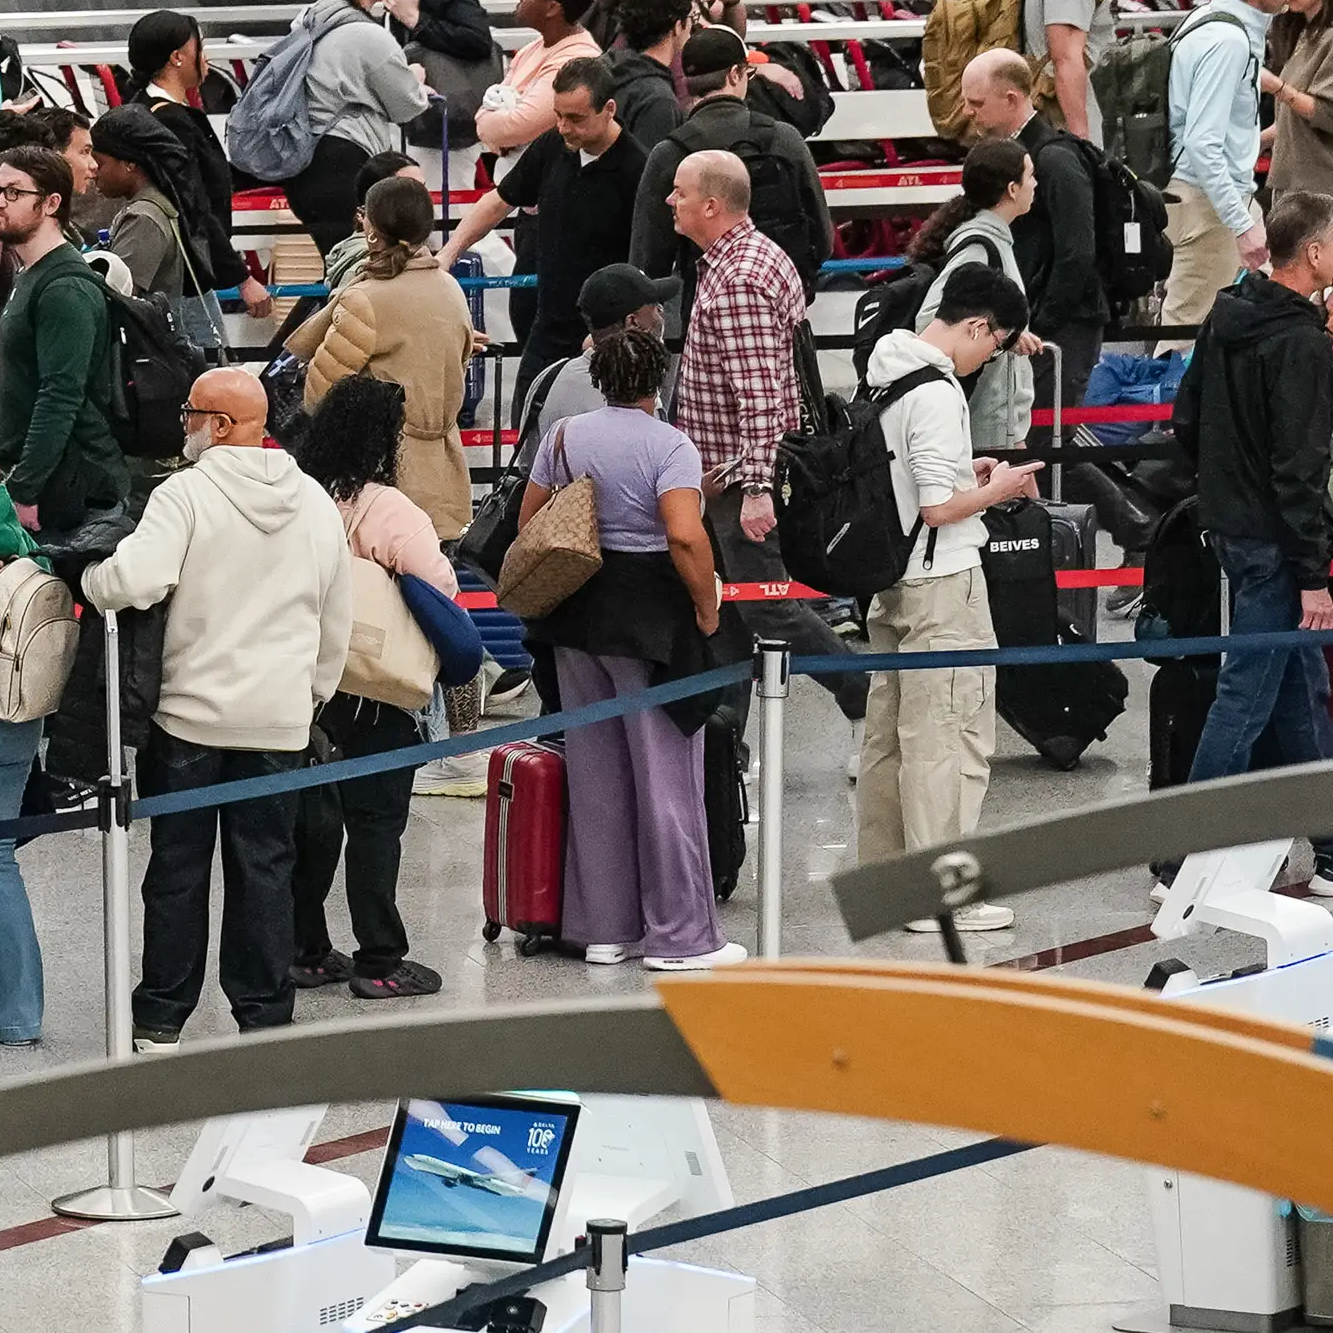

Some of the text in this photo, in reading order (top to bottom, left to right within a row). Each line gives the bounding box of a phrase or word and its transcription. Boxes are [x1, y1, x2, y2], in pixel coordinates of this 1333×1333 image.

[897, 175, 924, 186] ATL
[989, 538, 1040, 553] BEIVES
[759, 583, 790, 596] ATL
[441, 1119, 462, 1131] HERE
[463, 1122, 474, 1132] TO
[475, 1122, 502, 1135] BEGIN
[527, 1147, 549, 1155] YEARS
